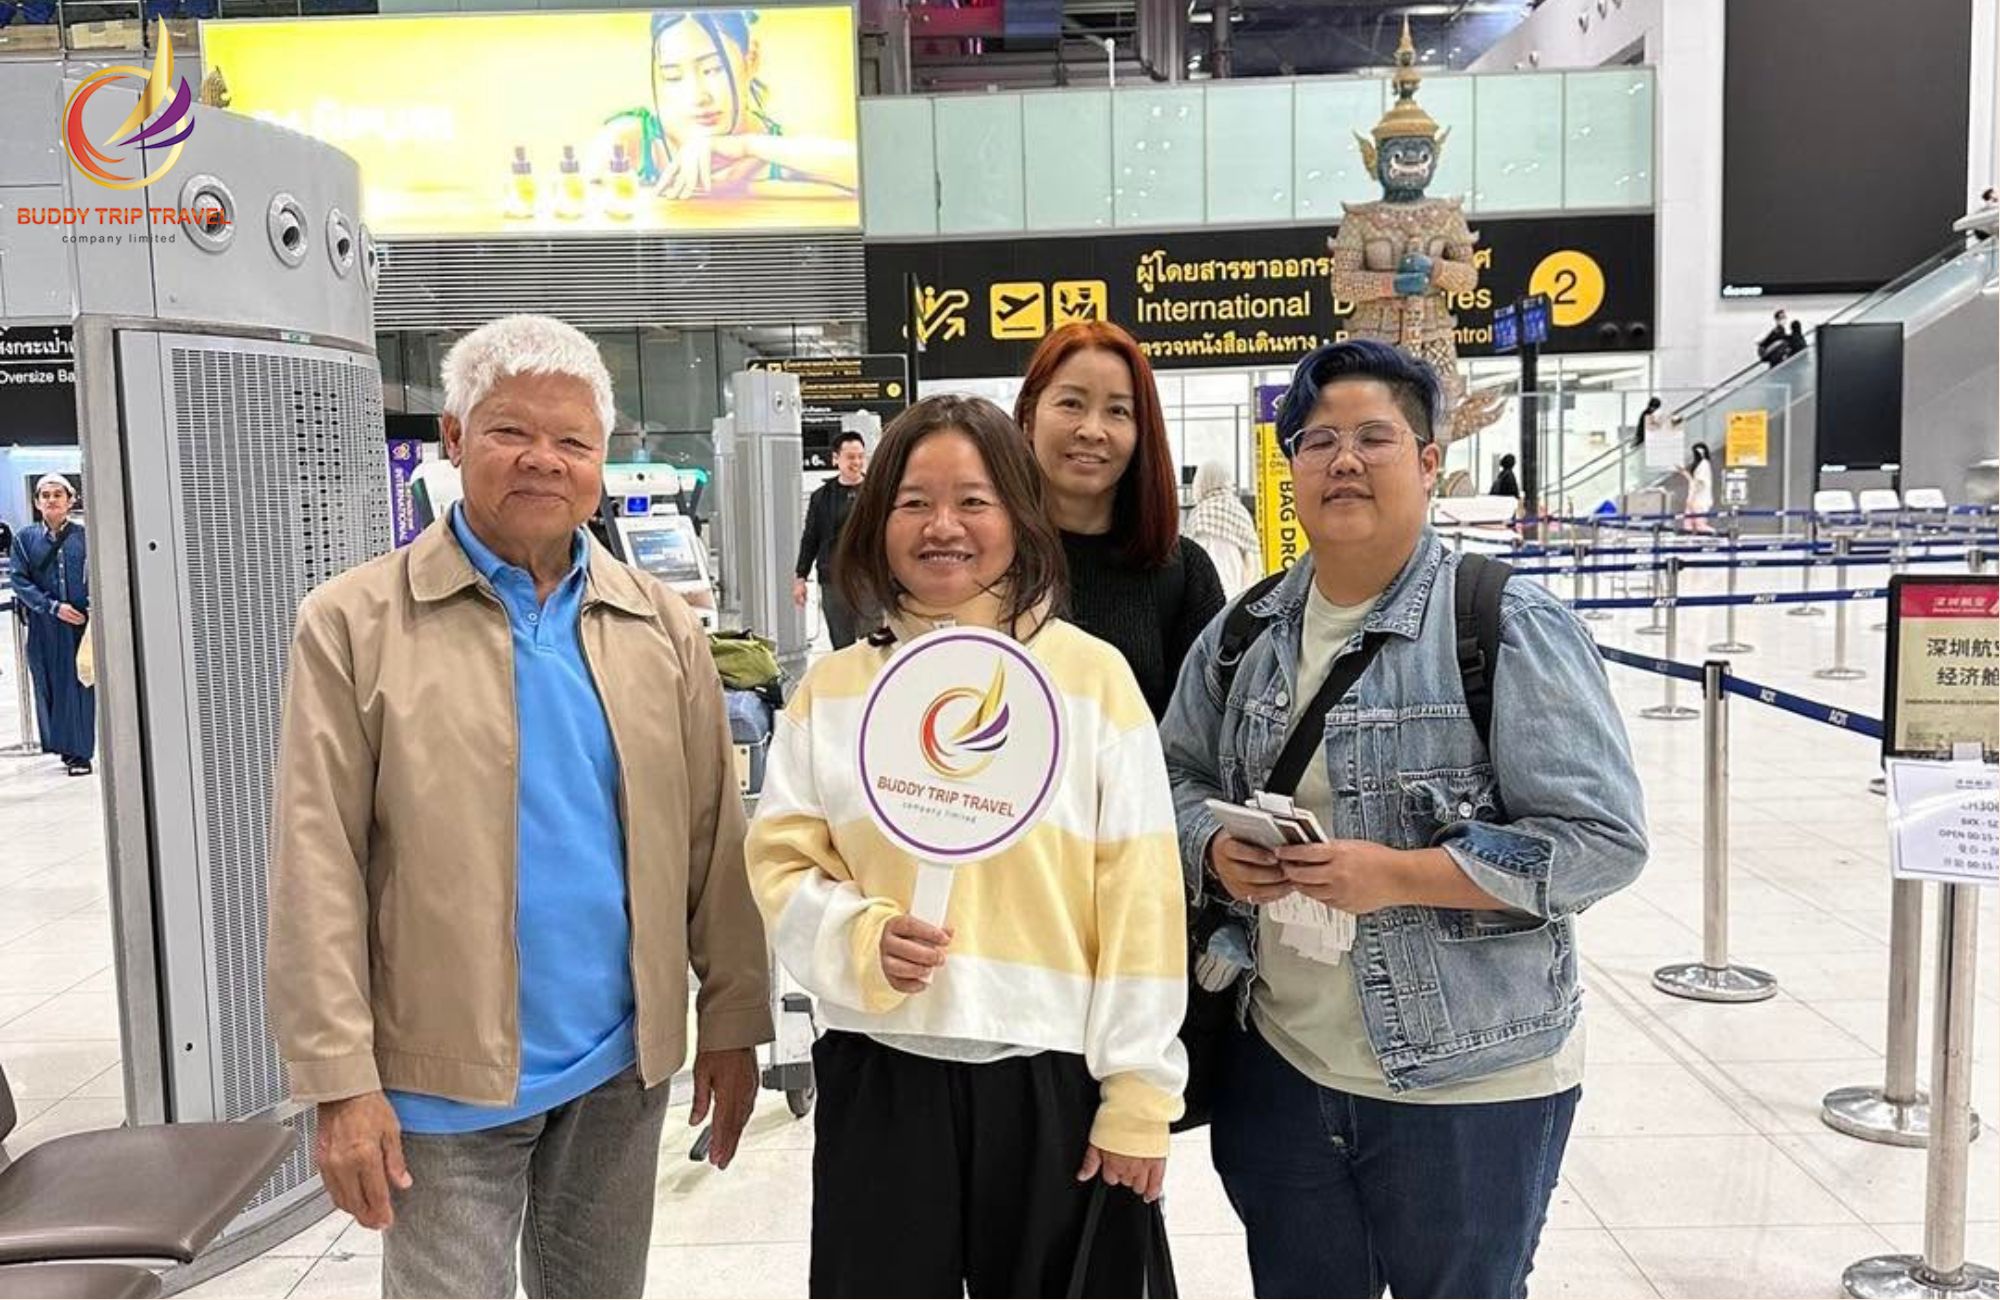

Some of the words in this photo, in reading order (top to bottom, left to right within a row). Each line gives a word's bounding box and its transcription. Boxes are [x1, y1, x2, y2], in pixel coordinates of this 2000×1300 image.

[1553, 269, 1578, 306] 2
[1137, 290, 1311, 323] International
[877, 776, 925, 797] BUDDY
[928, 787, 959, 804] TRIP
[963, 793, 1015, 817] TRAVEL
